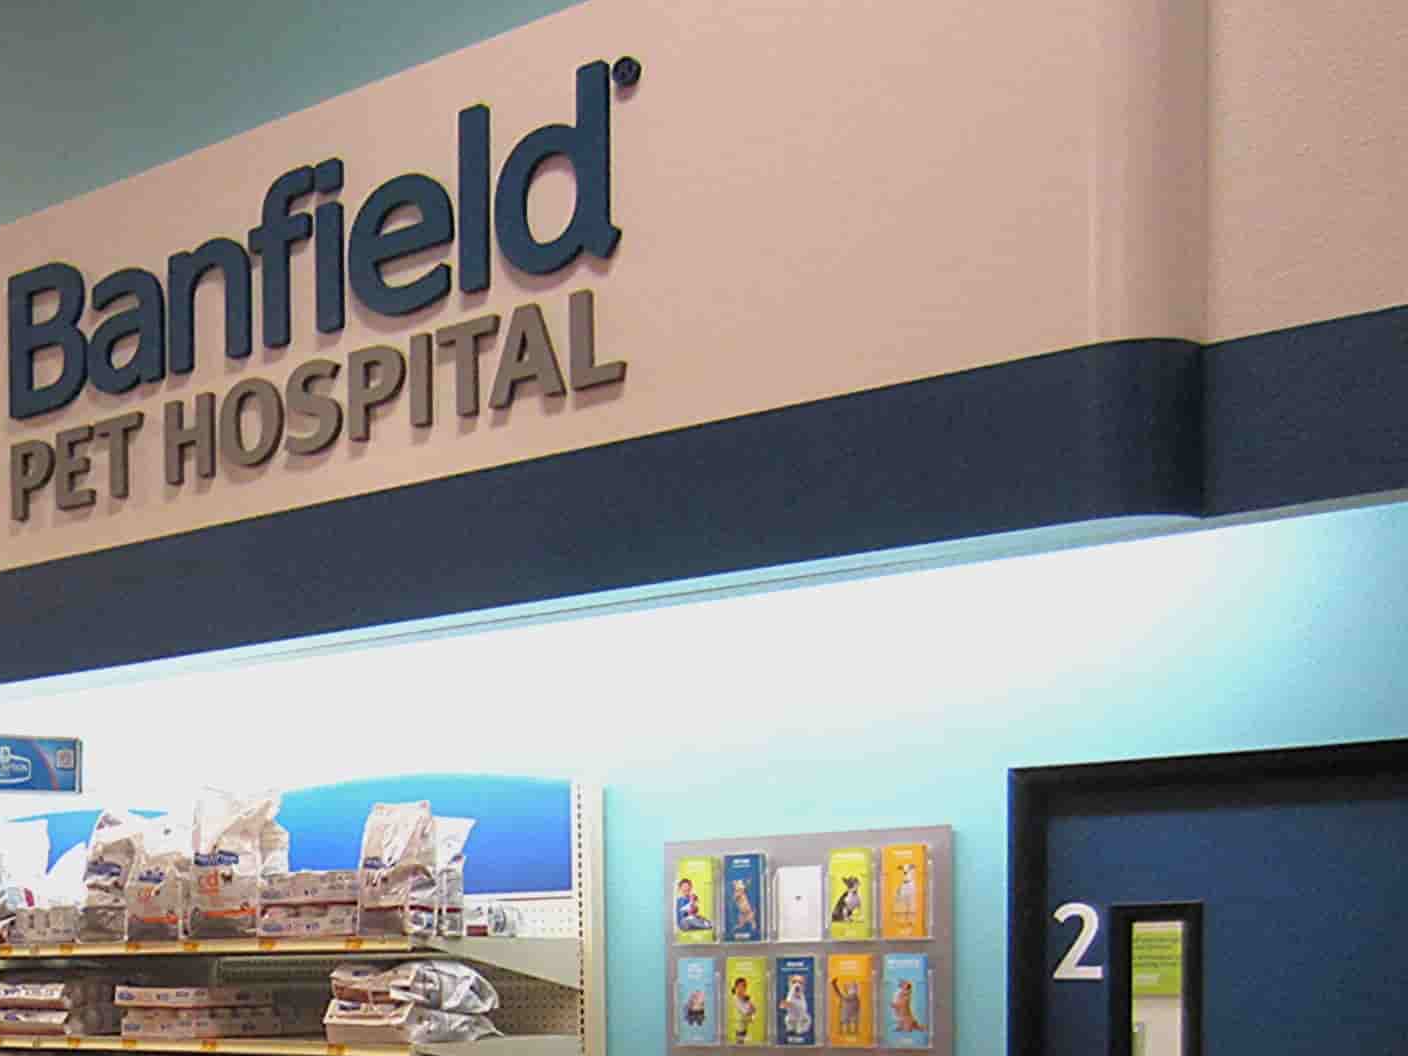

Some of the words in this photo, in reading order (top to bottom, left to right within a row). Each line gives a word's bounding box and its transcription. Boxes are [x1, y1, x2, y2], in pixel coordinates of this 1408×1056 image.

[7, 58, 628, 422] Banfield
[9, 412, 144, 522] PET
[163, 290, 627, 486] HOSPITAL
[1052, 902, 1104, 980] 2
